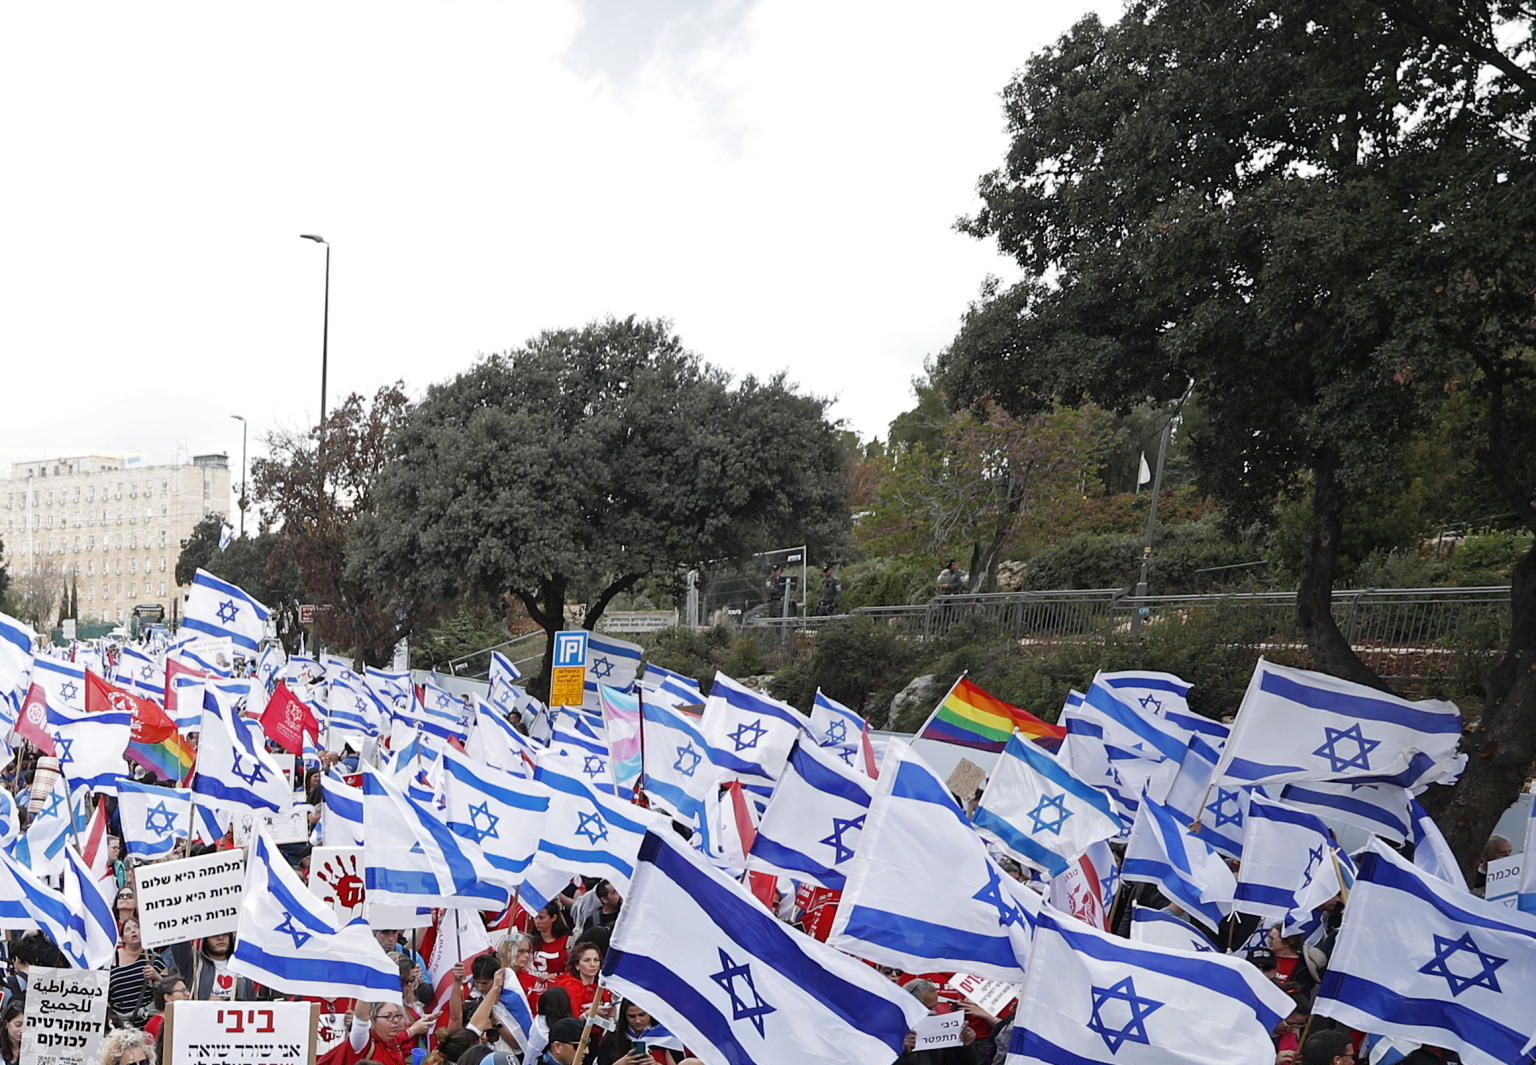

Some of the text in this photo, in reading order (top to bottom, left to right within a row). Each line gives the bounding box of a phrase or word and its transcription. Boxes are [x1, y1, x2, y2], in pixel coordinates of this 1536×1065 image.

[142, 876, 171, 889] שלום
[174, 871, 196, 882] היא
[145, 884, 242, 911] חירות היא עבדות
[182, 914, 202, 926] היא
[206, 907, 237, 920] בורות
[33, 978, 102, 998] ديمقراطية
[40, 999, 92, 1014] للجميع
[26, 1016, 102, 1032] דמוקרטיה
[216, 1010, 275, 1033] ביבי
[940, 1020, 960, 1028] ביבי
[922, 1033, 957, 1044] תתפטר
[188, 1044, 300, 1058] אני שורד שואה
